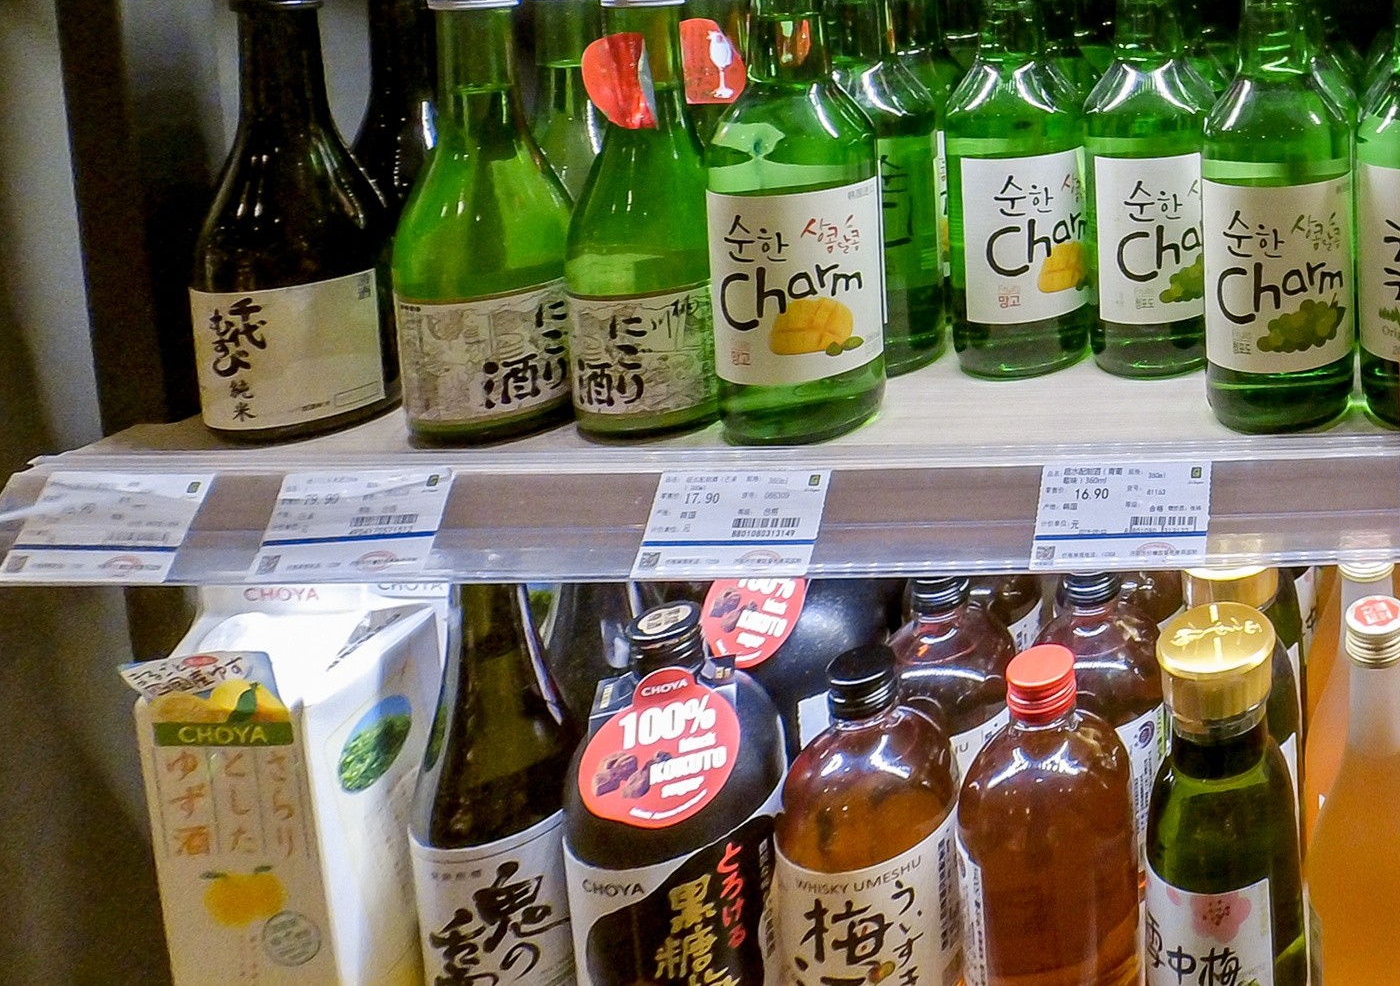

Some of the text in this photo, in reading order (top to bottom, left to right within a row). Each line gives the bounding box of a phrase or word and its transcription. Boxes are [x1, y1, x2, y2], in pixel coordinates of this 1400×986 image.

[994, 176, 1053, 216] 순한
[1124, 181, 1183, 222] 순한
[724, 215, 789, 262] 순한
[1117, 224, 1201, 281] Cha
[1223, 210, 1285, 258] 순한
[721, 264, 862, 331] Charm
[998, 296, 1021, 308] 망고
[1218, 262, 1343, 324] Charm
[535, 300, 568, 390] にごり
[610, 315, 647, 404] にごり
[229, 380, 256, 421] 純米
[483, 354, 541, 409] 酒
[578, 359, 614, 406] 酒
[685, 493, 720, 504] 17.90
[1075, 488, 1109, 500] 16.90
[1071, 520, 1079, 529] 元
[244, 588, 319, 602] CHOYA
[641, 679, 688, 696] CHOYA
[178, 726, 267, 744] CHOYA
[619, 695, 716, 749] 100%
[582, 879, 644, 896] CHOYA
[717, 842, 746, 949] とろける
[797, 856, 921, 894] WHISKY UMESHU
[795, 899, 894, 986] 梅
